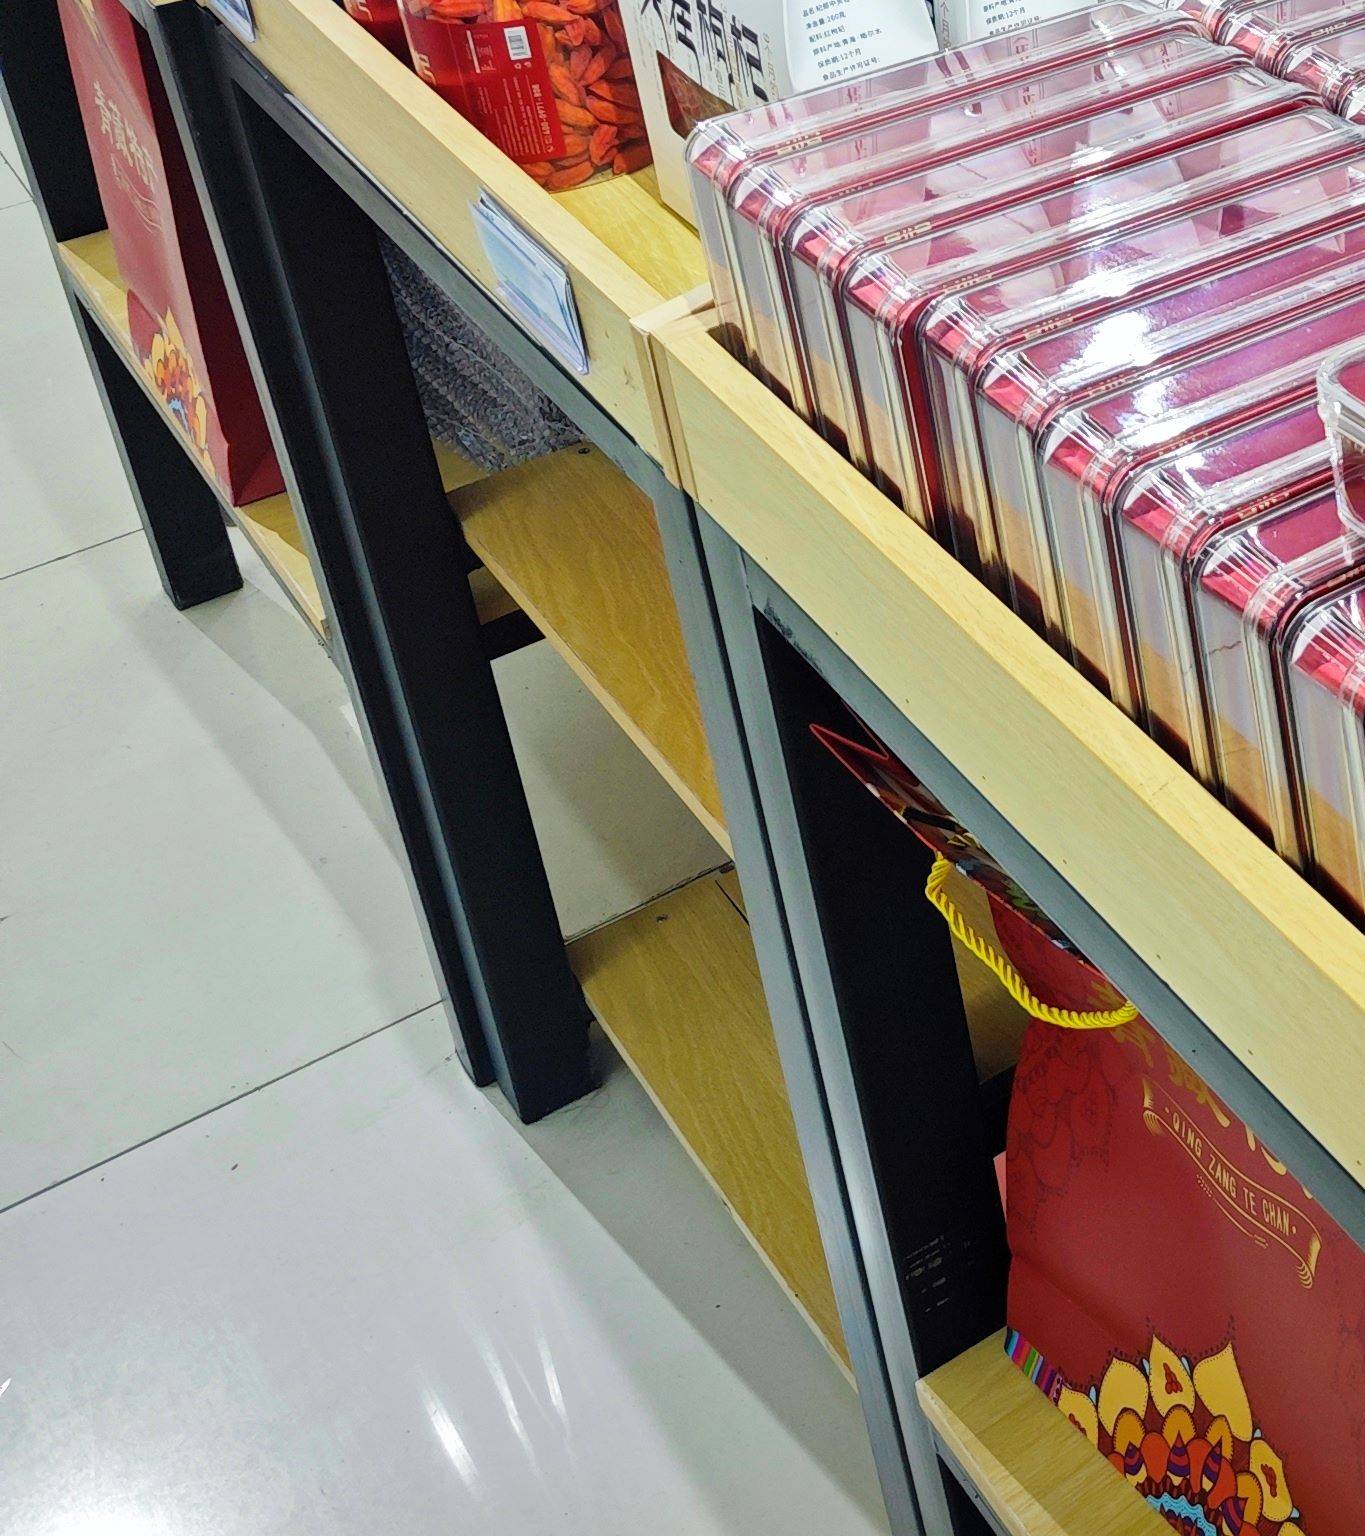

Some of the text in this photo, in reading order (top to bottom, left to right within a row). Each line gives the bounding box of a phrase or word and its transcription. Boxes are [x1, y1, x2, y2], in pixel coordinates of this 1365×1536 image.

[1170, 1113, 1290, 1236] QING ZANG TE CHAN
